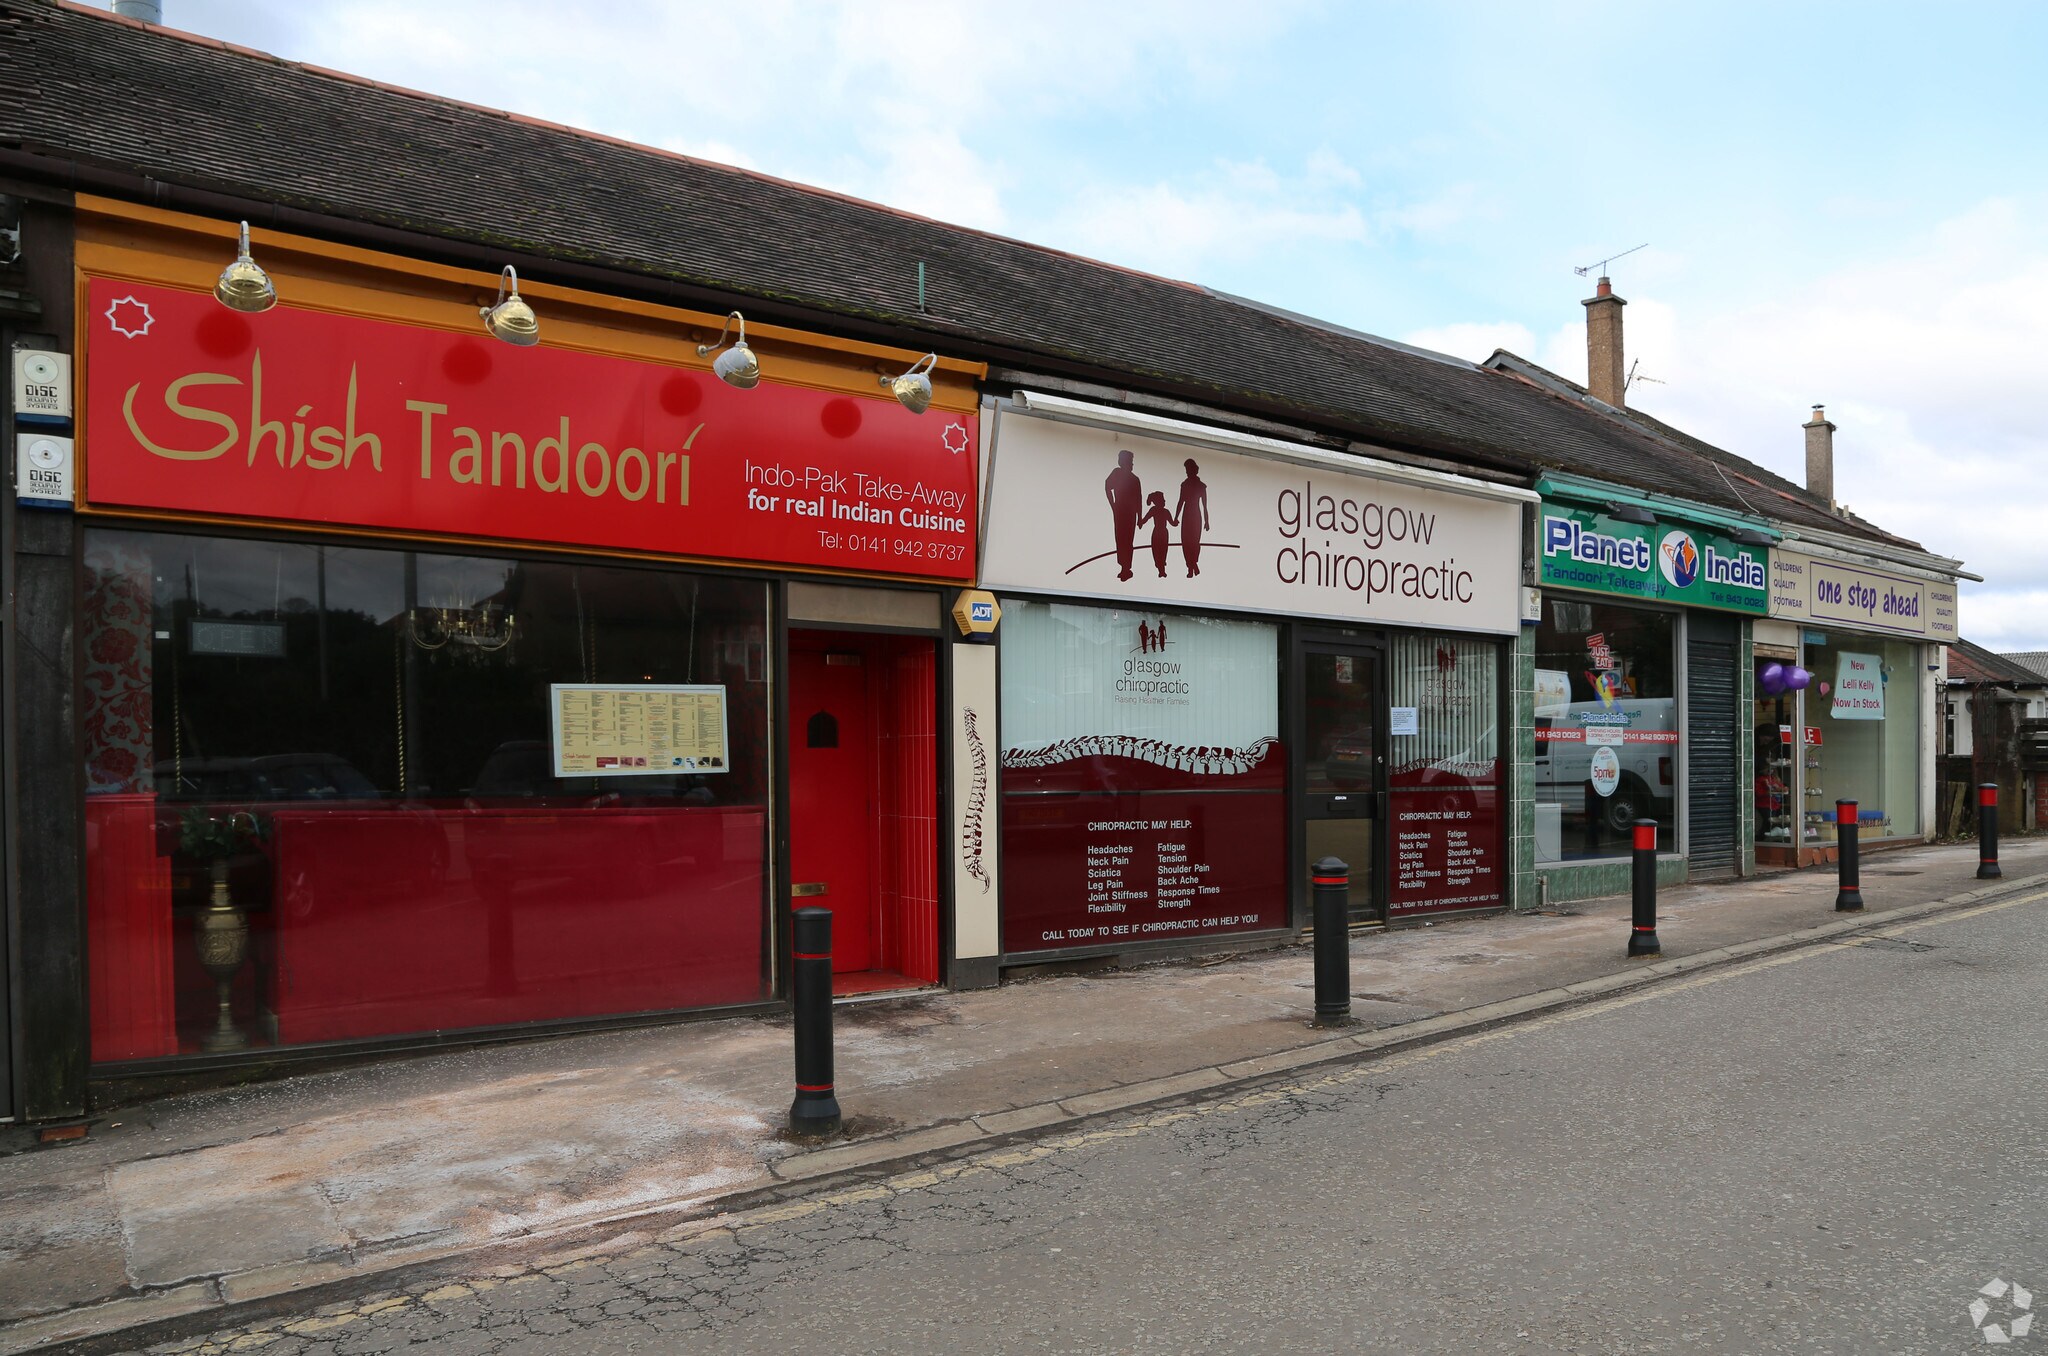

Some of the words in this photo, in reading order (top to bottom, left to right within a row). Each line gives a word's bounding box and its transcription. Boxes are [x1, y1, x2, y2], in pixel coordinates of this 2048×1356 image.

[26, 385, 57, 397] DISC
[121, 347, 382, 472] Shish
[30, 470, 61, 482] DISC
[30, 481, 61, 489] SECURITY
[745, 459, 847, 493] Indo-Pak
[853, 473, 966, 513] Take-Away
[748, 489, 778, 511] for
[786, 496, 824, 517] real
[832, 499, 893, 524] Indian
[900, 507, 965, 533] Cuisine
[1277, 481, 1435, 550] glasgow
[817, 531, 843, 549] Tel:
[849, 535, 887, 553] 0141
[894, 539, 923, 557] 942
[927, 543, 965, 561] 3737
[1544, 515, 1650, 572] Planet
[1705, 545, 1765, 590] India
[1277, 538, 1473, 604] chiropractic
[1774, 561, 1802, 574] CHILDRENS
[1544, 563, 1603, 584] Tandoori
[1608, 572, 1667, 597] Takeaway
[1774, 579, 1796, 590] QUALITY
[1726, 594, 1741, 605] 943
[1743, 597, 1765, 608] 0023
[1774, 596, 1802, 608] FOOTWEAR
[1818, 579, 1842, 604] one
[1848, 581, 1876, 617] step
[1883, 586, 1919, 617] ahead
[1931, 592, 1952, 602] CHILDRENS
[973, 605, 992, 618] ADT
[1936, 607, 1953, 617] QUALITY
[1931, 622, 1953, 632] FOOTWEAR
[1591, 646, 1609, 657] JUST
[1124, 657, 1181, 677] glasgow
[1596, 657, 1608, 667] EAT
[1850, 660, 1865, 671] New
[1116, 677, 1189, 696] chiropractic
[1843, 679, 1857, 690] Lelli
[1859, 680, 1875, 692] Kelly
[1833, 697, 1851, 708] Now
[1853, 698, 1861, 708] In
[1862, 698, 1880, 709] Stock
[1581, 712, 1608, 722] Planet
[1609, 713, 1628, 723] India
[1400, 812, 1441, 820] CHIROPRACTIC
[1088, 821, 1148, 831] CHIROPRACTIC
[1152, 821, 1167, 829] MAY
[1171, 820, 1192, 828] HELP:
[1399, 832, 1431, 840] Headaches
[1447, 830, 1467, 838] Fatigue
[1088, 845, 1133, 854] Headaches
[1158, 843, 1185, 853] Fatigue
[1447, 849, 1471, 857] Shoulder
[1088, 857, 1109, 866] Neck
[1112, 856, 1129, 864] Pain
[1158, 854, 1187, 863] Tension
[1158, 865, 1191, 874] Shoulder
[1194, 864, 1209, 872] Pain
[1400, 862, 1410, 870] Leg
[1088, 868, 1121, 878] Sciatica
[1400, 871, 1414, 879] Joint
[1416, 870, 1441, 878] Stiffness
[1447, 868, 1473, 876] Response
[1088, 881, 1103, 890] Leg
[1107, 880, 1123, 888] Pain
[1158, 877, 1177, 885] Back
[1180, 876, 1199, 884] Ache
[1399, 880, 1426, 889] Flexibility
[1447, 877, 1471, 885] Strength
[1088, 893, 1108, 902] Joint
[1112, 890, 1148, 900] Stiffness
[1158, 888, 1195, 898] Response
[1198, 886, 1220, 894] Times
[1088, 903, 1126, 913] Flexibility
[1158, 899, 1191, 909] Strength
[1042, 931, 1064, 940] CALL
[1068, 928, 1095, 938] TODAY
[1099, 927, 1109, 936] TO
[1112, 925, 1129, 934] SEE
[1132, 924, 1139, 933] IF
[1142, 919, 1199, 932] CHIROPRACTIC
[1202, 918, 1218, 927] CAN
[1220, 916, 1239, 925] HELP
[1242, 914, 1258, 923] YOU!
